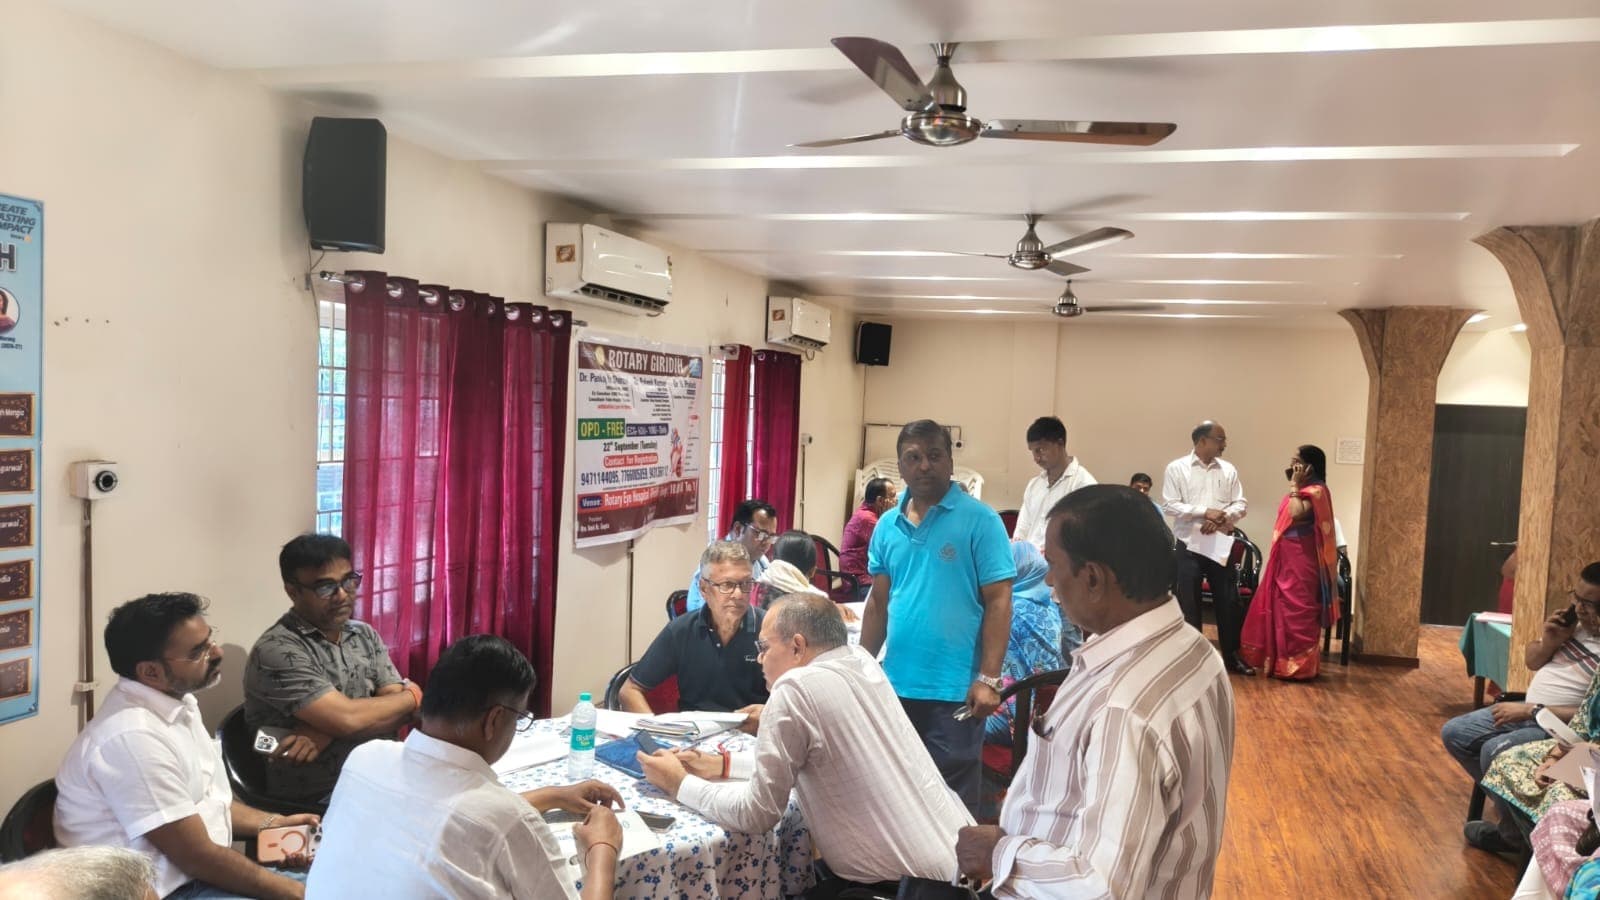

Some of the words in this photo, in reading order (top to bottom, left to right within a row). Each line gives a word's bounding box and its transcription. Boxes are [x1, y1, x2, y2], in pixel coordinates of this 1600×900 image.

[0, 203, 28, 216] EATE
[608, 349, 648, 370] ROTARY
[581, 422, 600, 437] OPD
[606, 421, 625, 436] FREE
[614, 441, 639, 453] September
[604, 493, 623, 508] Rotary
[623, 491, 632, 506] Eye
